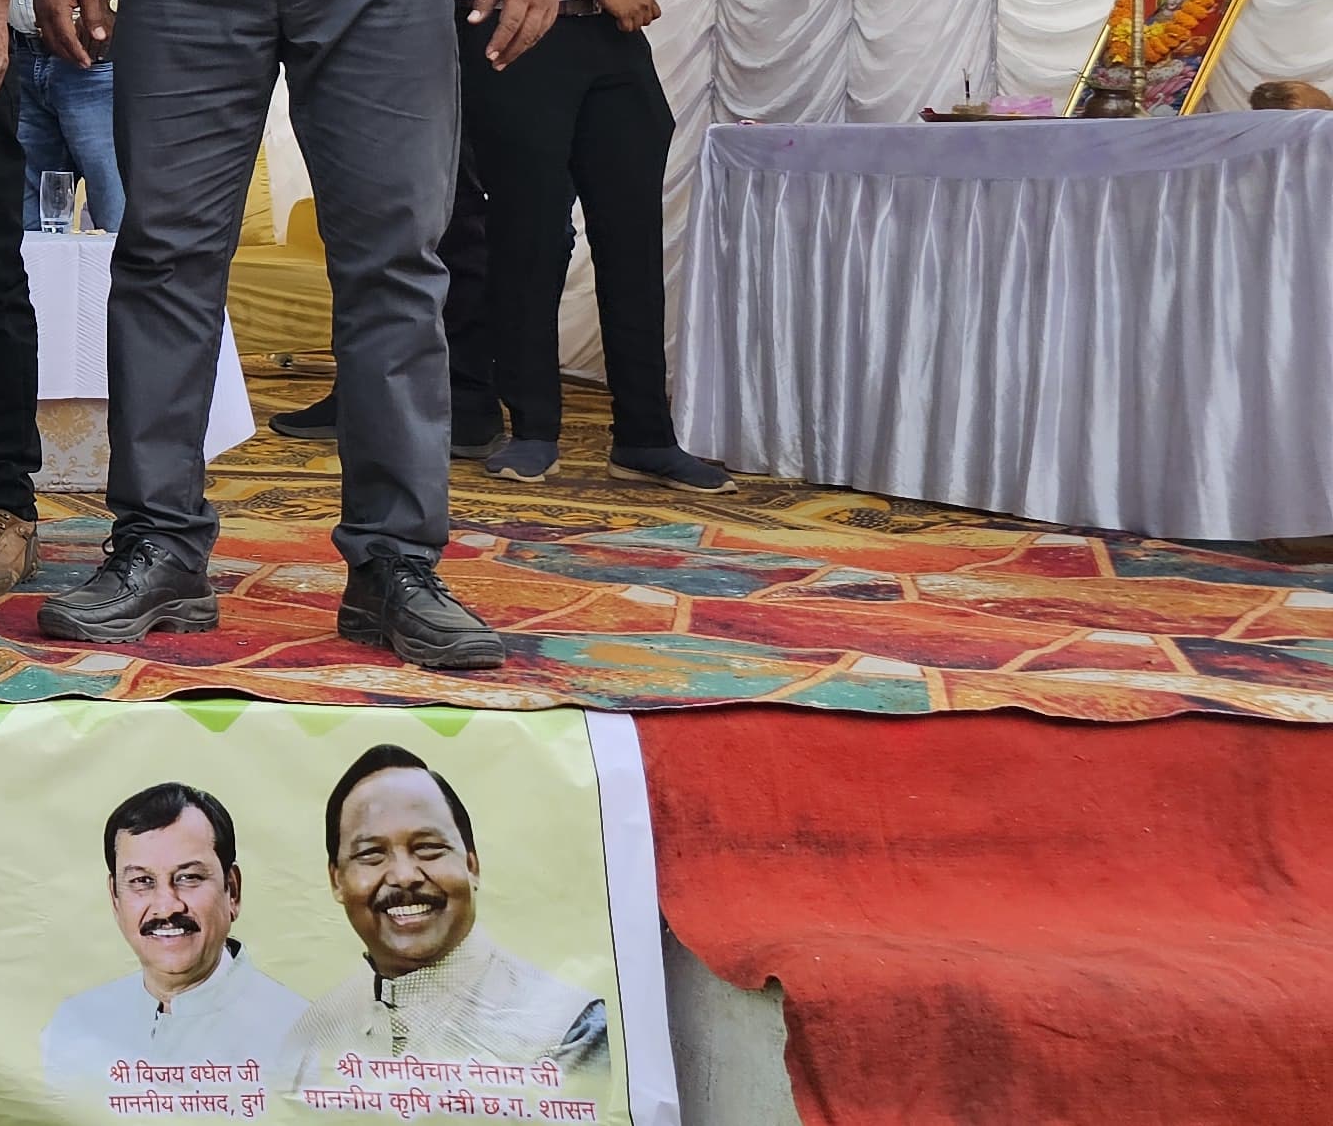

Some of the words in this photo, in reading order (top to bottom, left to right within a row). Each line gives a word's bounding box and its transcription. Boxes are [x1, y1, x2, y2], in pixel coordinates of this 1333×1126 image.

[109, 1059, 131, 1083] श्री
[135, 1059, 184, 1083] विजय
[189, 1059, 232, 1083] बघेल
[237, 1058, 260, 1082] जी
[336, 1052, 362, 1079] श्री
[369, 1055, 462, 1083] रामविचार
[468, 1058, 525, 1087] नेताम
[109, 1090, 174, 1114] माननीय
[178, 1090, 234, 1116] सांसद,
[240, 1087, 266, 1118] दुर्ग
[303, 1084, 382, 1111] माननीय
[389, 1087, 431, 1120] कृषि
[437, 1088, 475, 1115] मंत्री
[481, 1094, 532, 1118] छ.ग.
[539, 1098, 596, 1122] शासन
